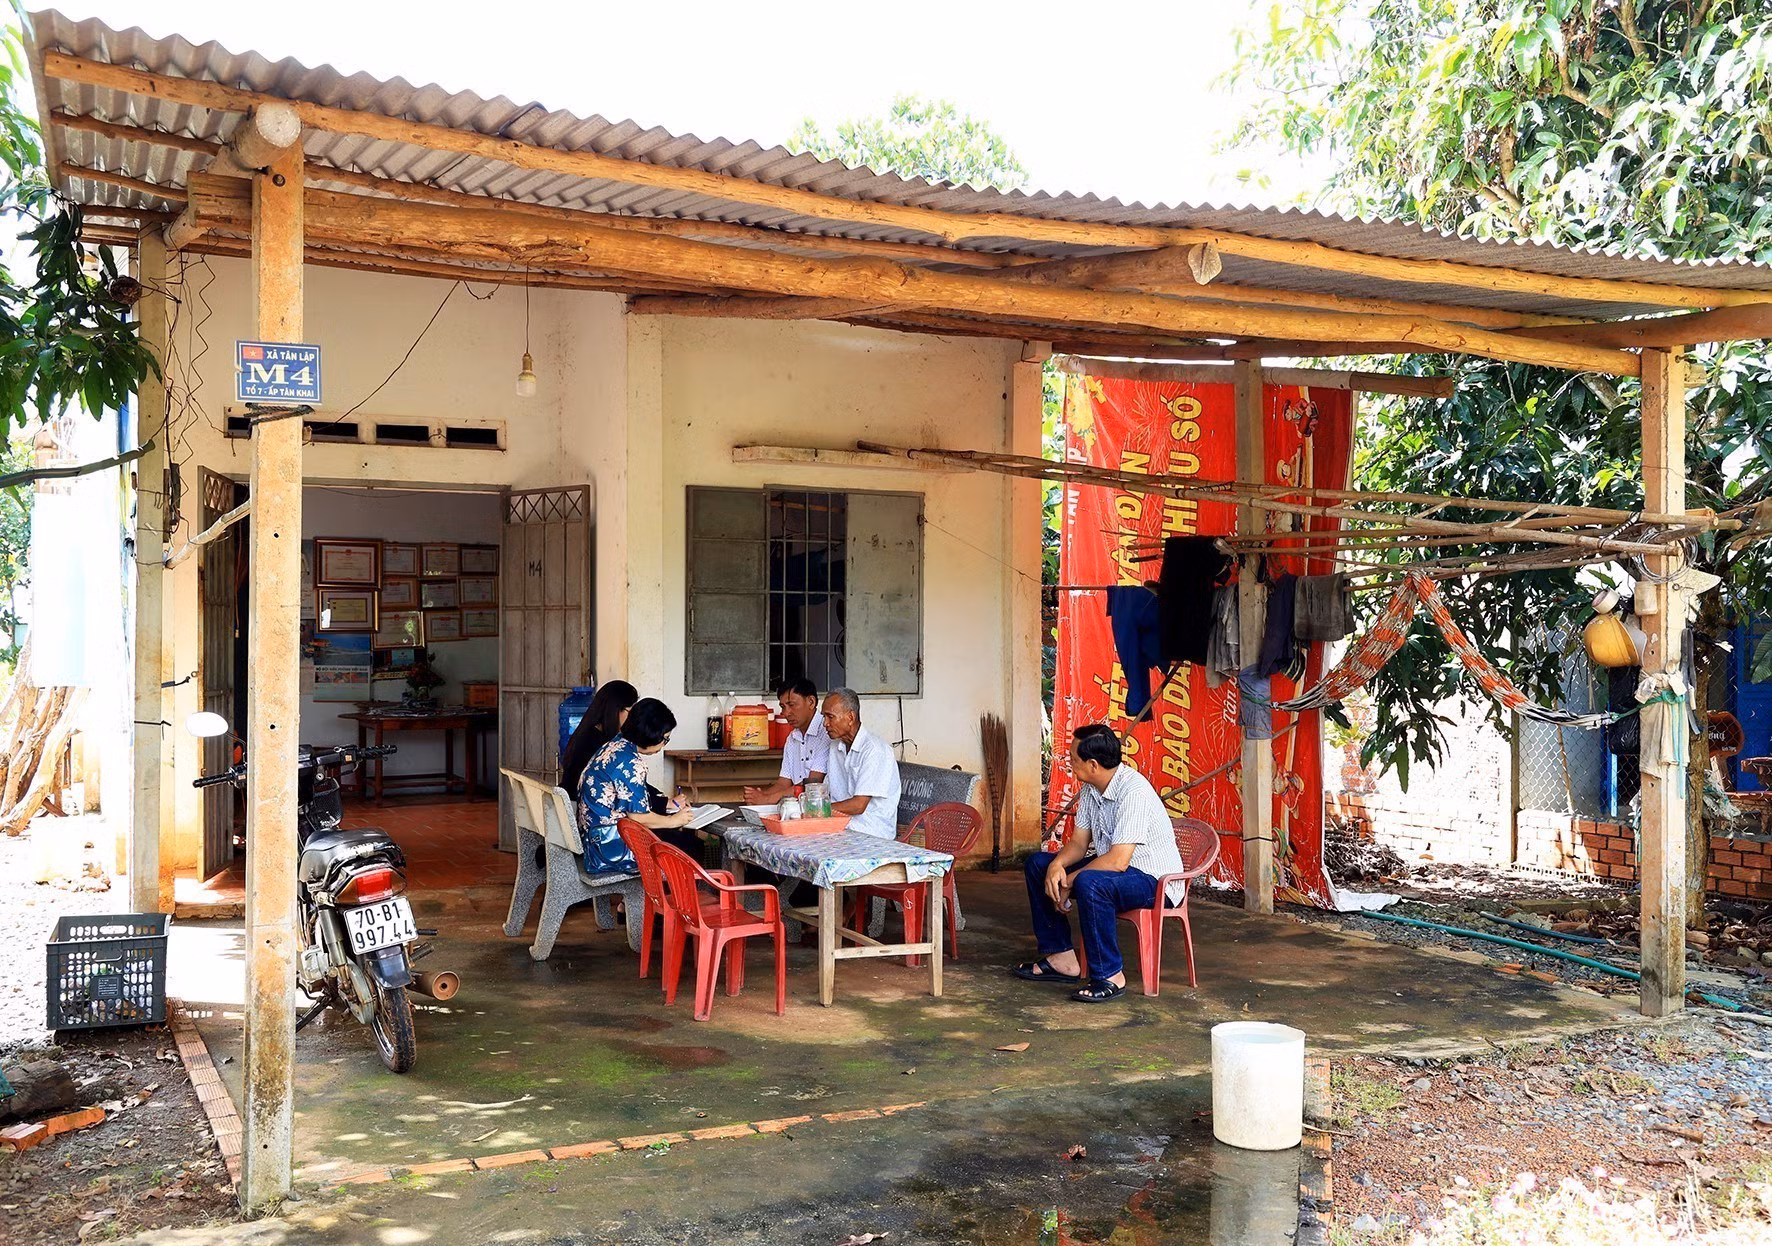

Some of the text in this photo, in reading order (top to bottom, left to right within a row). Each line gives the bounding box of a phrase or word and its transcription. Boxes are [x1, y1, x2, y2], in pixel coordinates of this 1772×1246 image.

[266, 349, 315, 363] XÃ TÂN LẬP
[246, 362, 314, 386] M4
[296, 389, 314, 397] KHAI
[1159, 394, 1203, 442] SỐ
[1115, 450, 1151, 521] ĐN
[528, 559, 542, 577] M4
[1223, 689, 1237, 726] Tân
[1154, 712, 1191, 785] BÀO
[355, 902, 401, 928] 70-B1
[355, 920, 412, 949] 997.44
